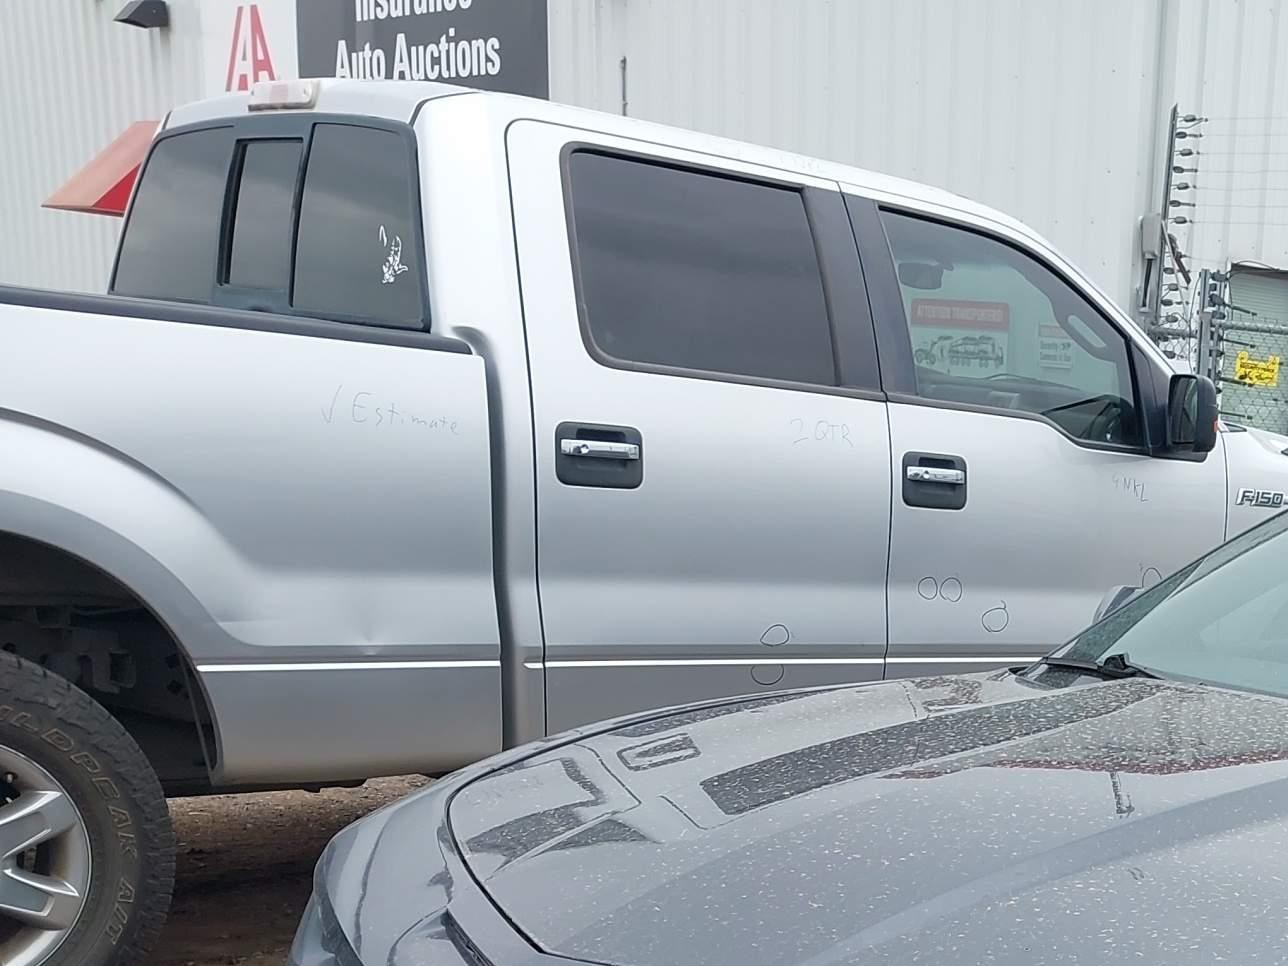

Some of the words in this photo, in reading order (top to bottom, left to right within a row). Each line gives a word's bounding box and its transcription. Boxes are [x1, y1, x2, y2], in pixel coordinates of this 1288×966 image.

[336, 40, 385, 80] Auto
[393, 28, 501, 80] Auctions
[351, 391, 460, 435] Estimate
